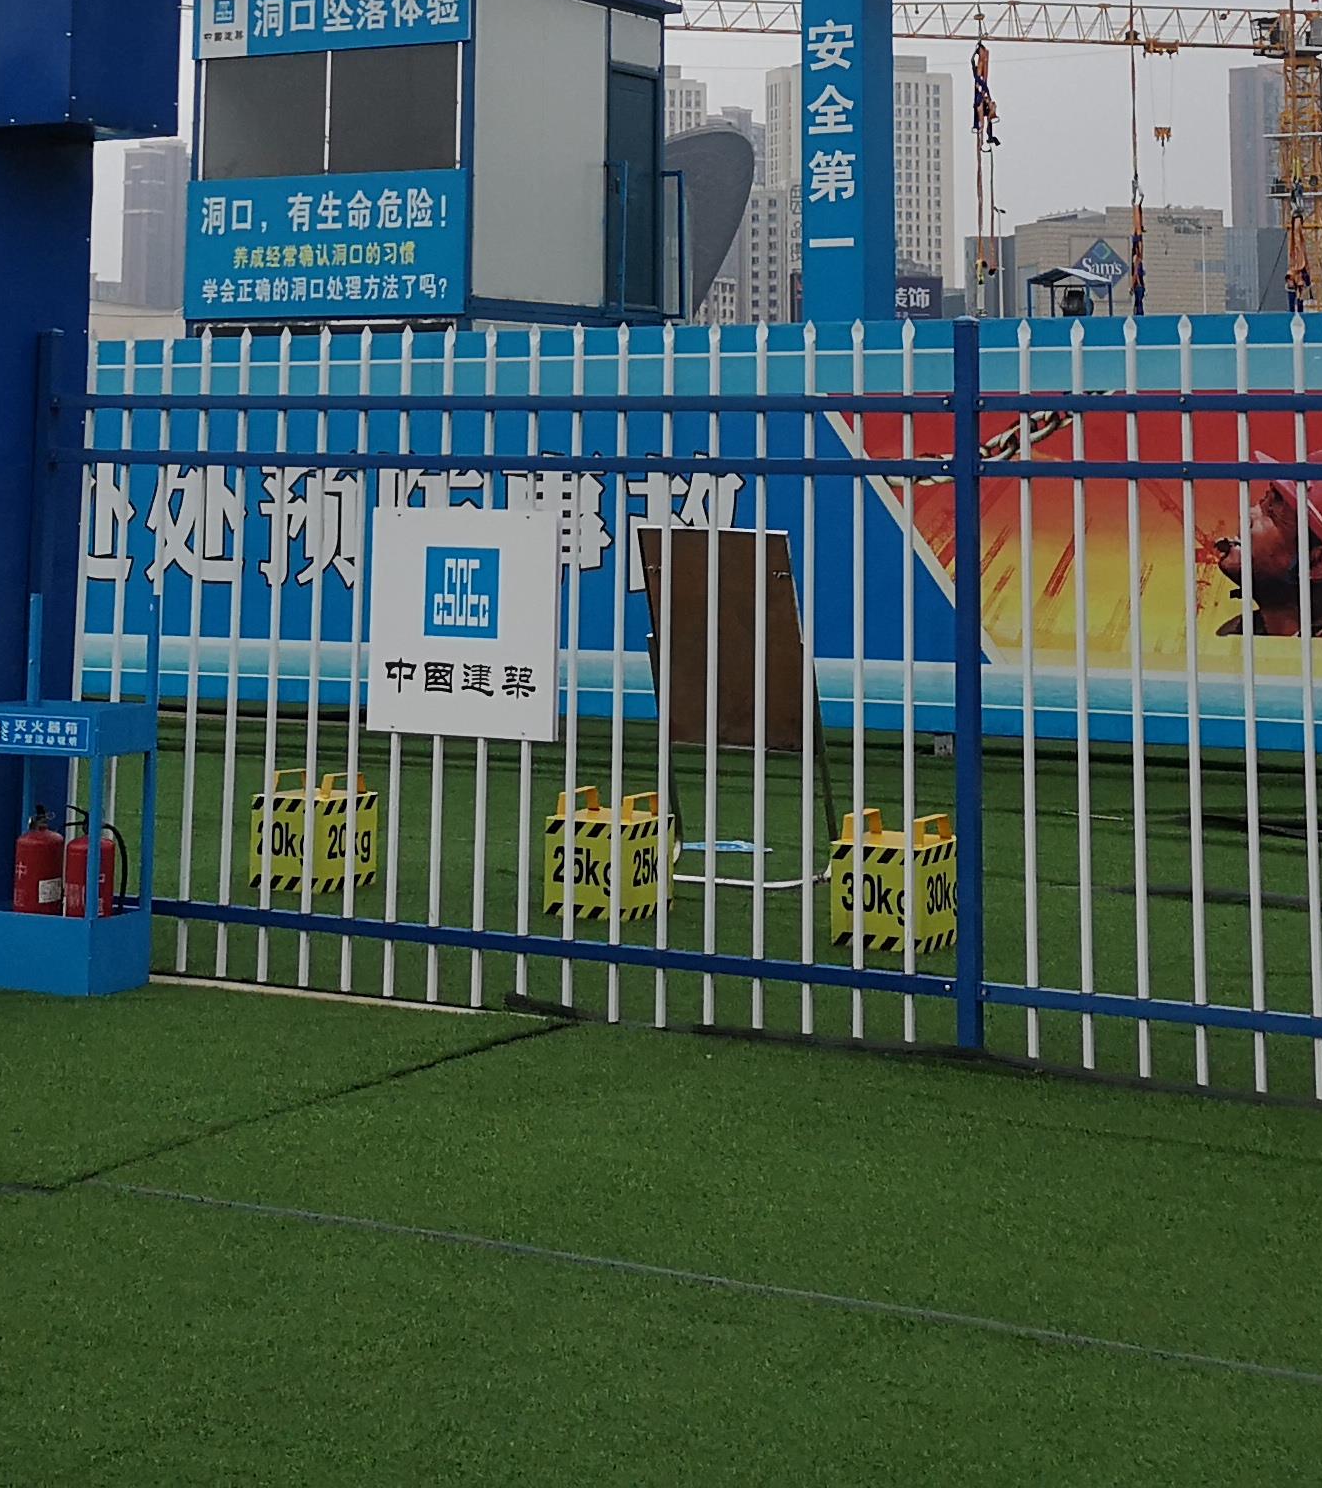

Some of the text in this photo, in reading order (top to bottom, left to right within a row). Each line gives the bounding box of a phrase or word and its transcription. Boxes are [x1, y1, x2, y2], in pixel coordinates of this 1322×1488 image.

[806, 18, 857, 249] 安全第一
[233, 241, 416, 270] 养成经常确认洞口的习惯
[384, 657, 538, 699] 中國建築
[14, 719, 78, 735] 灭火器箱
